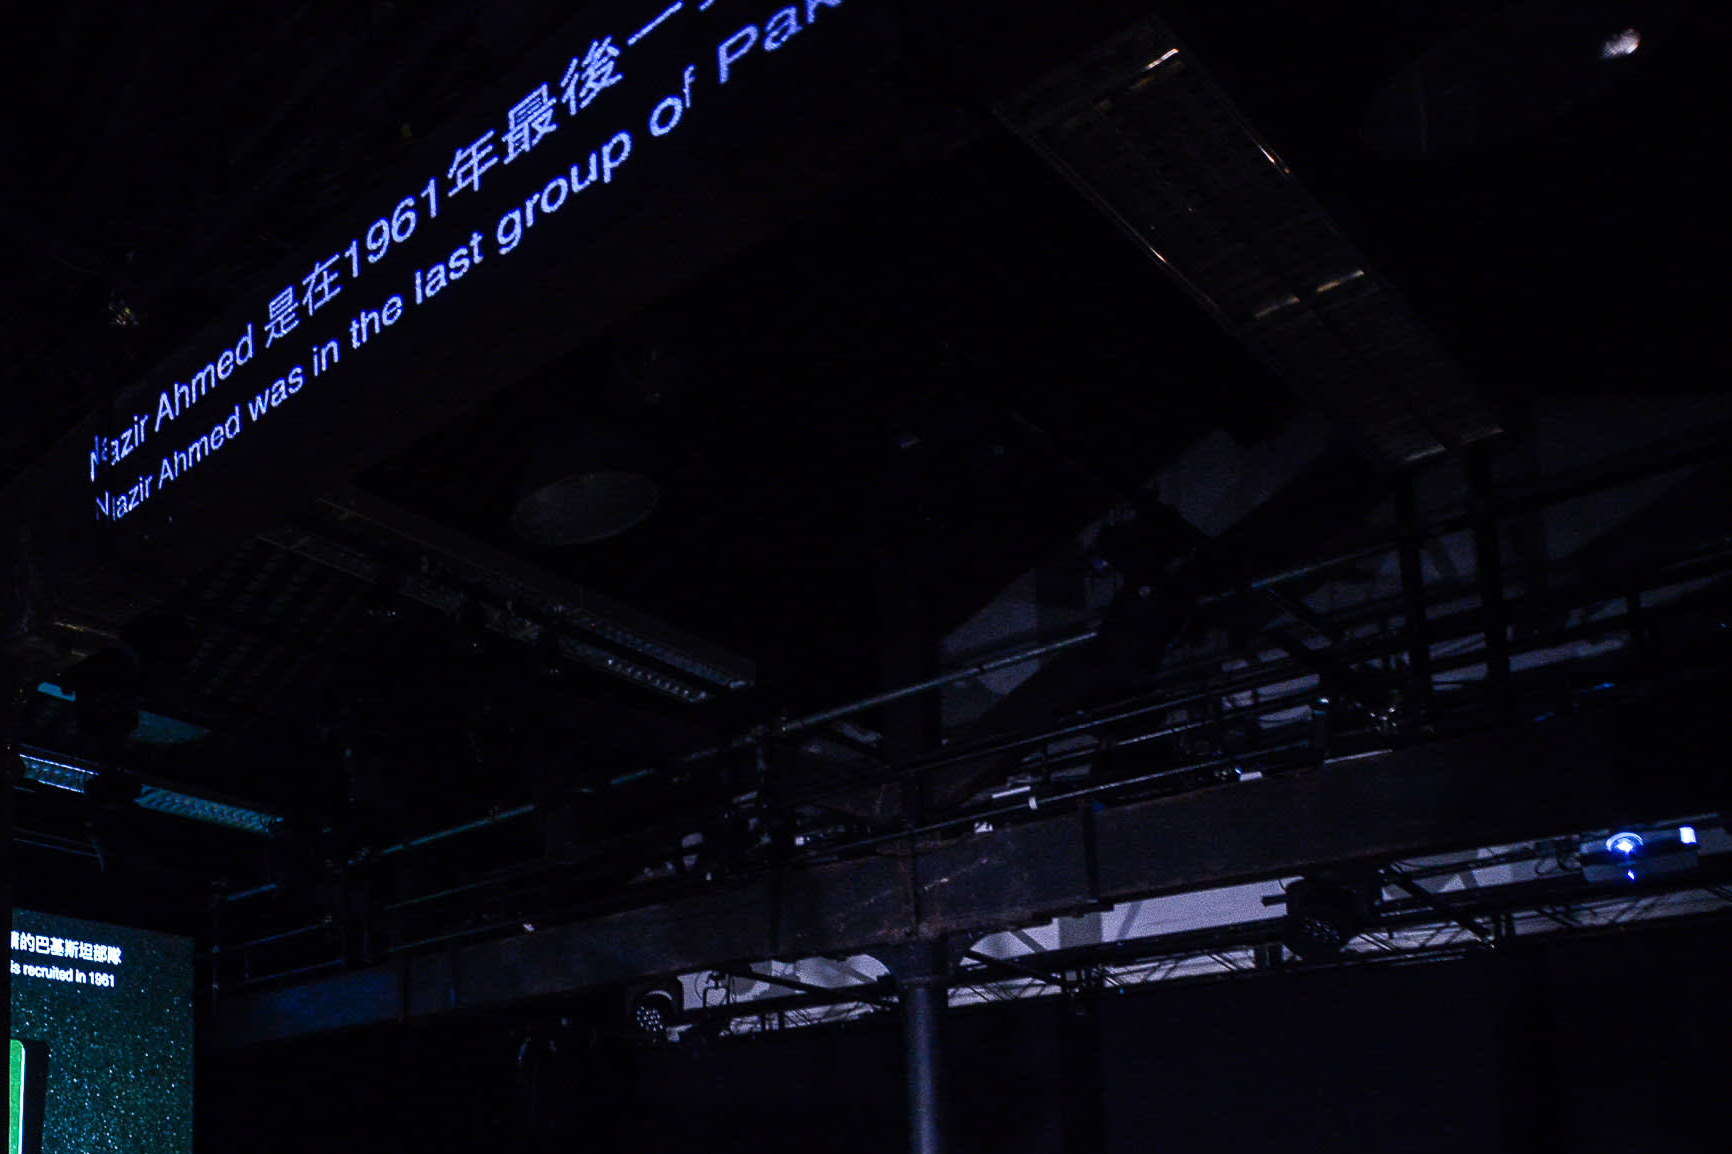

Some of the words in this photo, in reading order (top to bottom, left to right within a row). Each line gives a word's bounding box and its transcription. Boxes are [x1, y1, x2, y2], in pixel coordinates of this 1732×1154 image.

[90, 413, 149, 483] Nazir
[154, 322, 254, 433] Ahmed
[265, 0, 716, 349] 是在1961年最後一
[96, 473, 154, 522] Nazir
[157, 403, 242, 491] Ahmed
[248, 364, 304, 422] was
[312, 338, 341, 377] in
[349, 294, 404, 350] the
[415, 230, 485, 305] last
[496, 131, 632, 255] group
[649, 63, 696, 137] of
[22, 964, 74, 983] recruited
[75, 968, 87, 984] in
[89, 971, 115, 988] 1961
